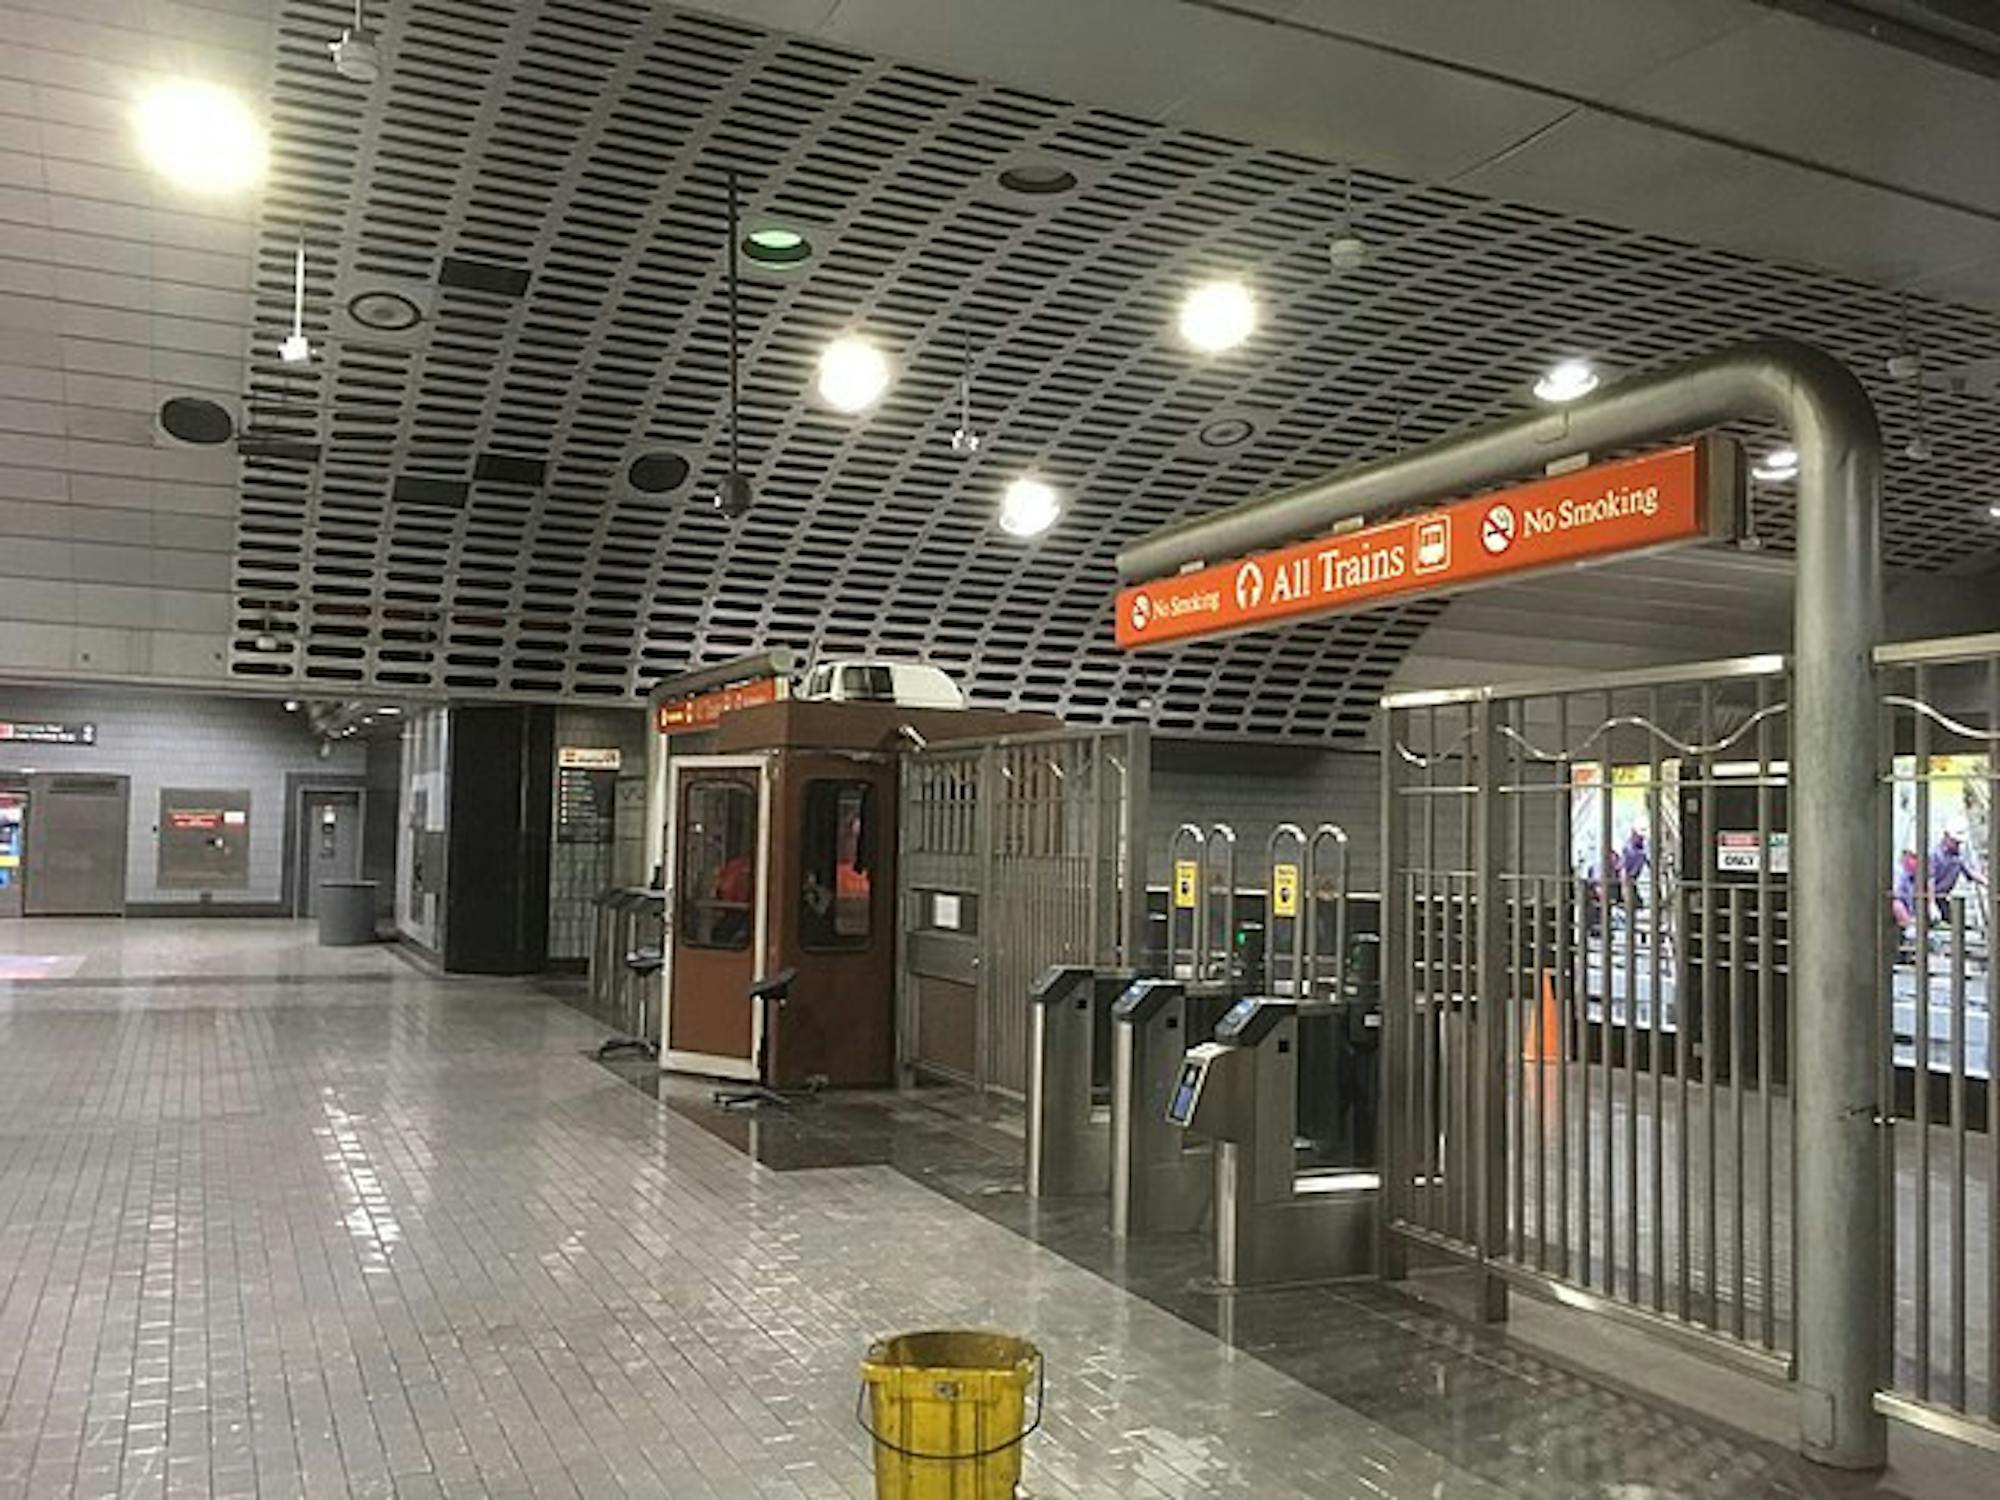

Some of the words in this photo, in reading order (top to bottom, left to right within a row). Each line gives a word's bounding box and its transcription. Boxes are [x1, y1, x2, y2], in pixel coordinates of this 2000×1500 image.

[1523, 507, 1557, 539] No
[1558, 486, 1660, 530] Smoking
[1270, 558, 1312, 604] All
[1317, 542, 1406, 593] Trains
[1151, 599, 1170, 621] No
[1170, 591, 1220, 618] Smoking
